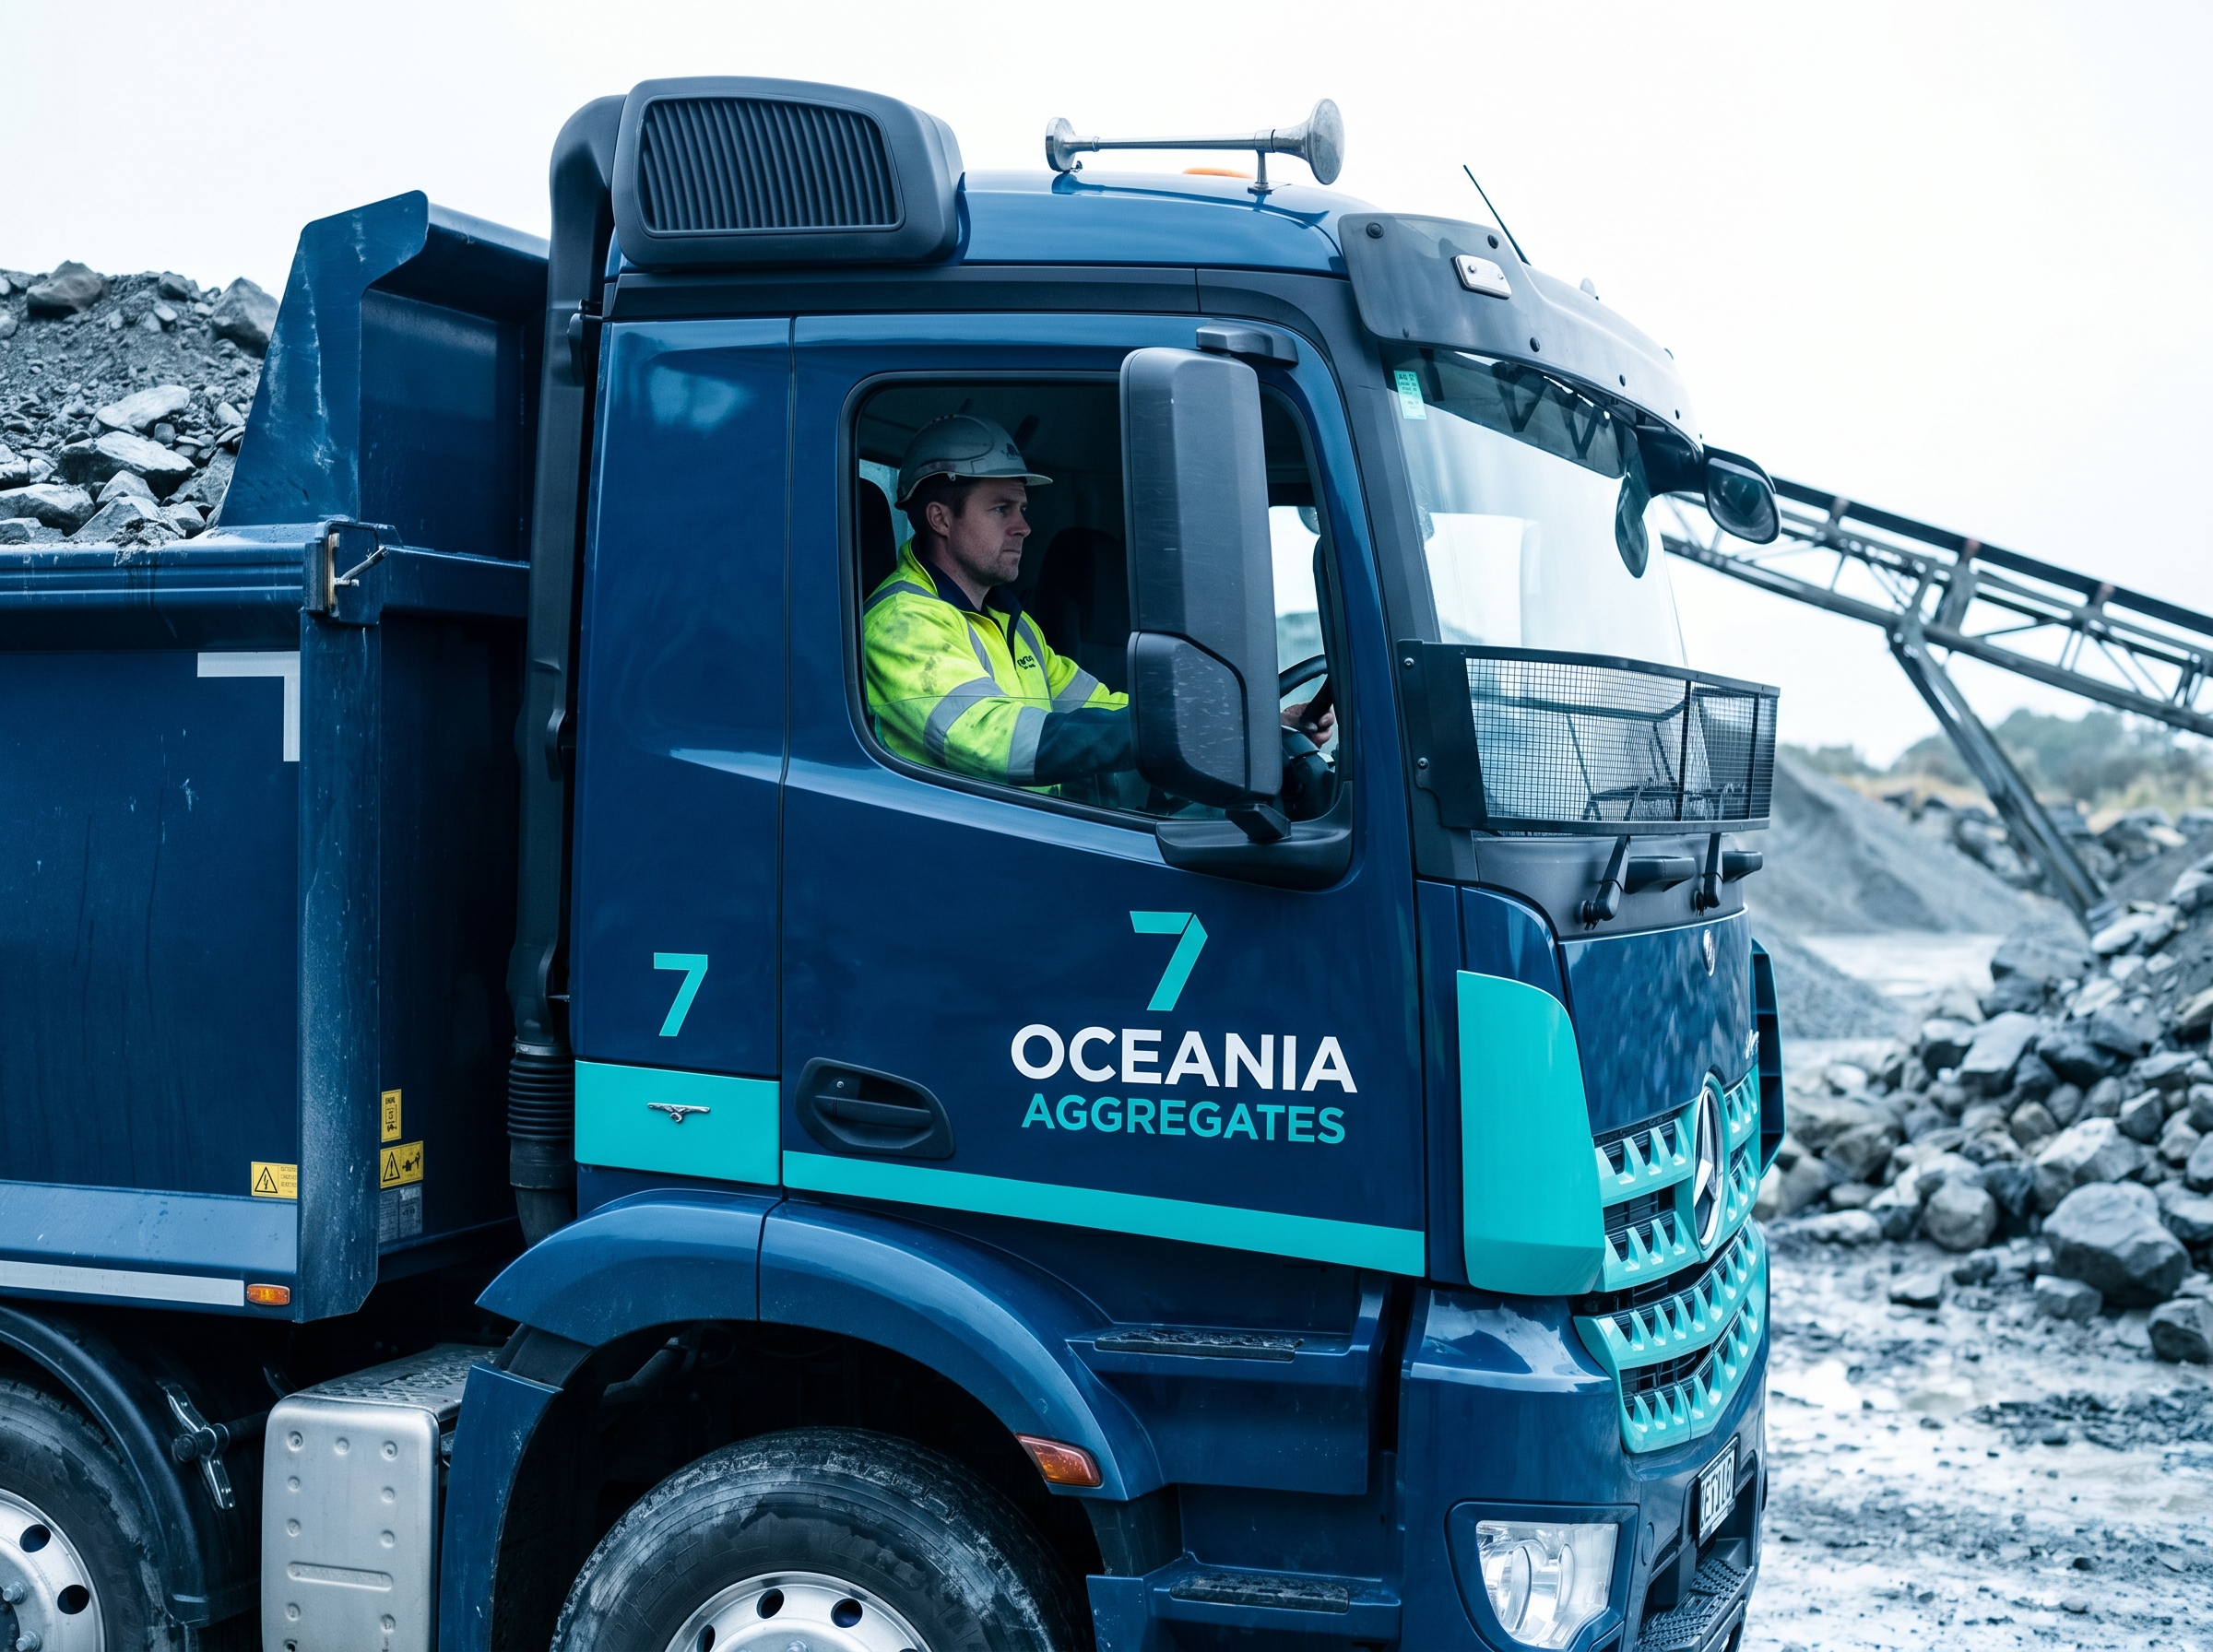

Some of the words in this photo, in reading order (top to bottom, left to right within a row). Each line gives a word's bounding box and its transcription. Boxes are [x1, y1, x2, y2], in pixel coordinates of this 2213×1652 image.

[654, 952, 708, 1037] 7
[1130, 911, 1208, 1011] 7
[1011, 1024, 1358, 1093] OCEANIA
[1022, 1093, 1345, 1144] AGGREGATES
